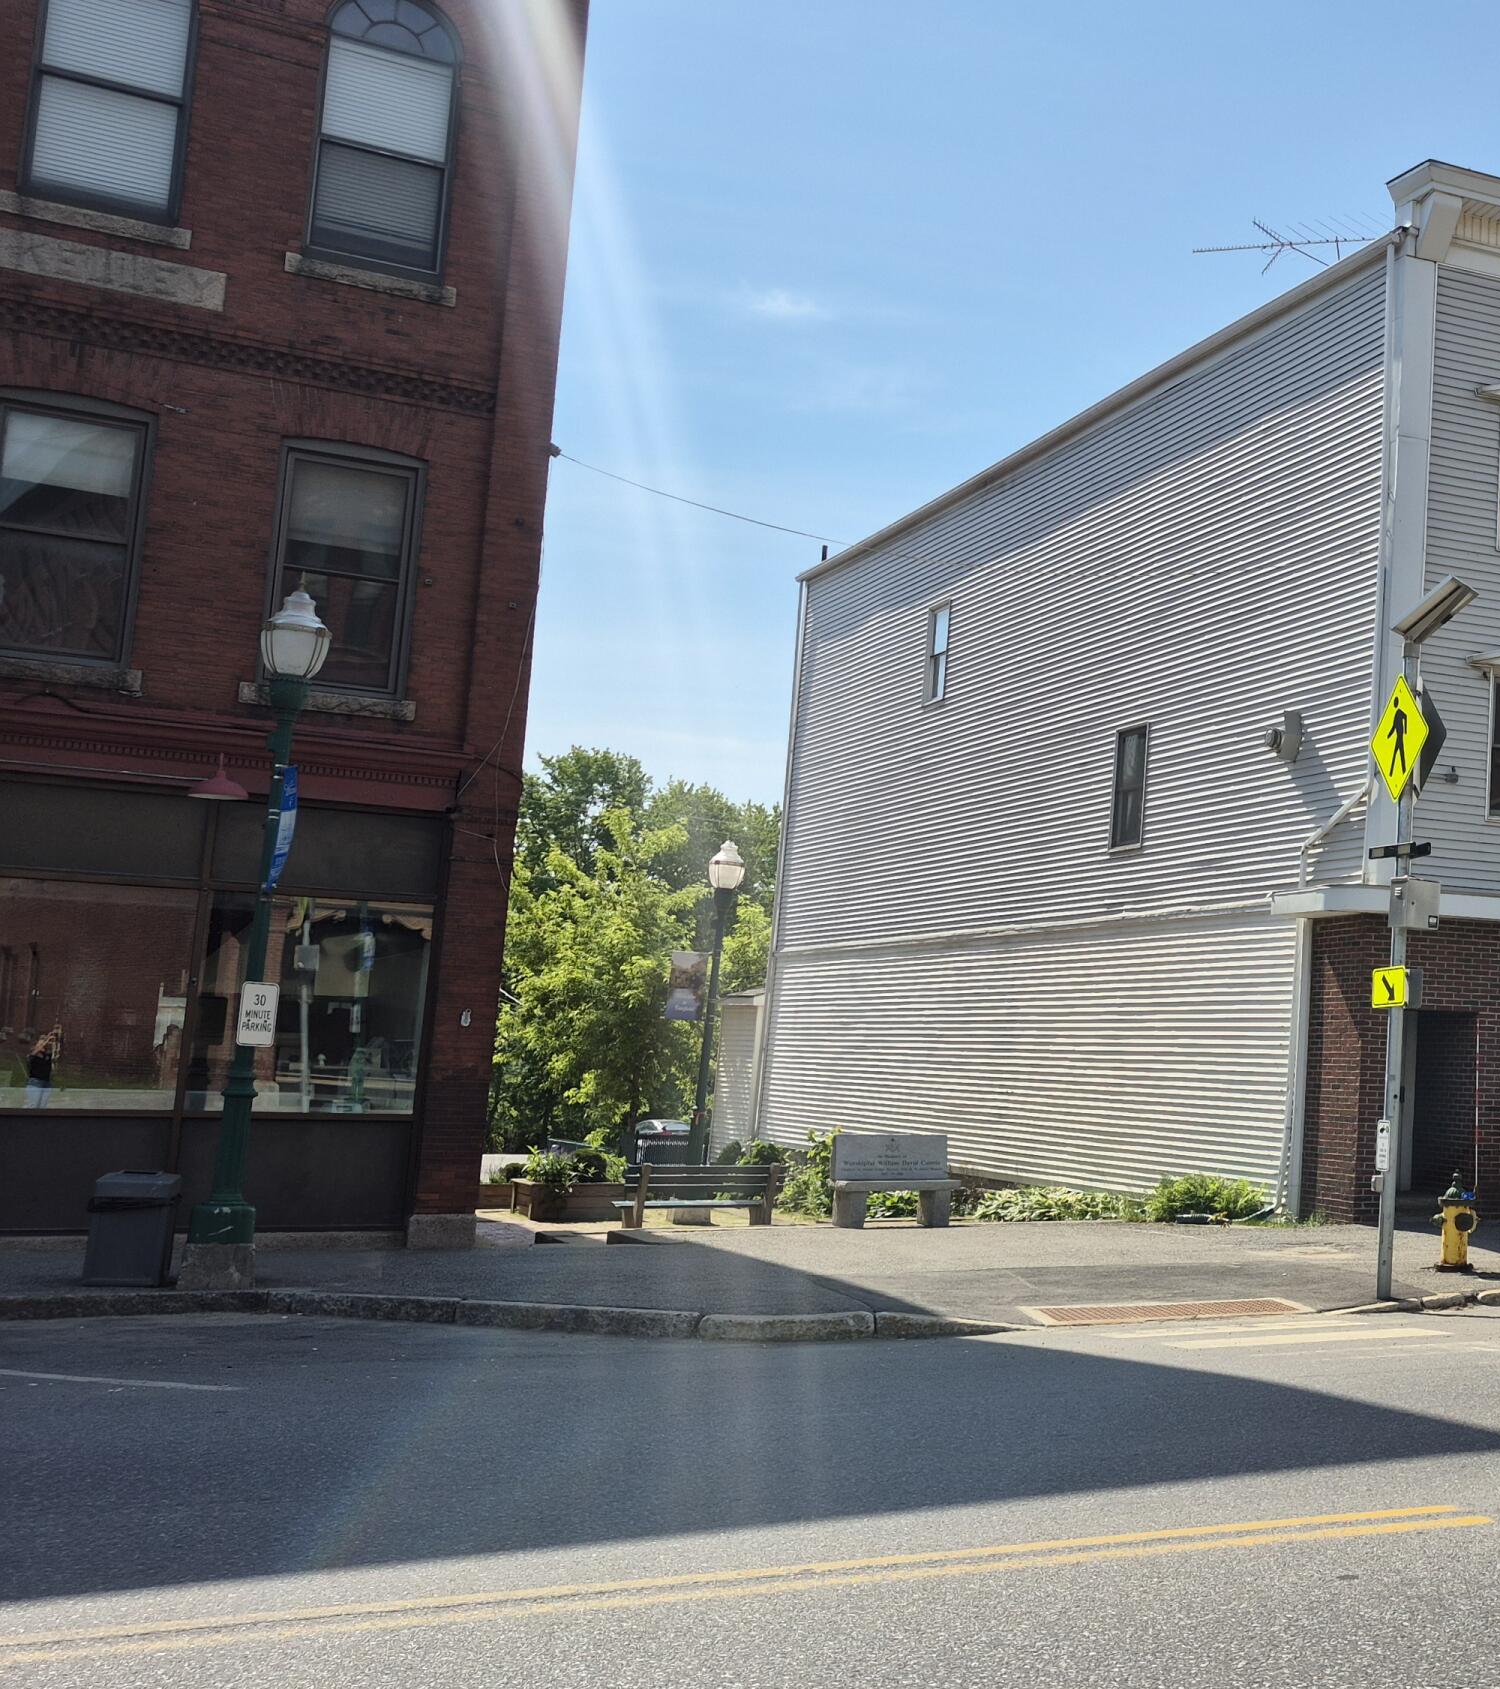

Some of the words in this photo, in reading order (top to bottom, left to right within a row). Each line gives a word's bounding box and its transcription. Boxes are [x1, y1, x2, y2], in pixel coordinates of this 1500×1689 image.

[253, 993, 267, 1007] 30
[245, 1009, 272, 1020] MINUTE
[241, 1021, 272, 1033] PARKING
